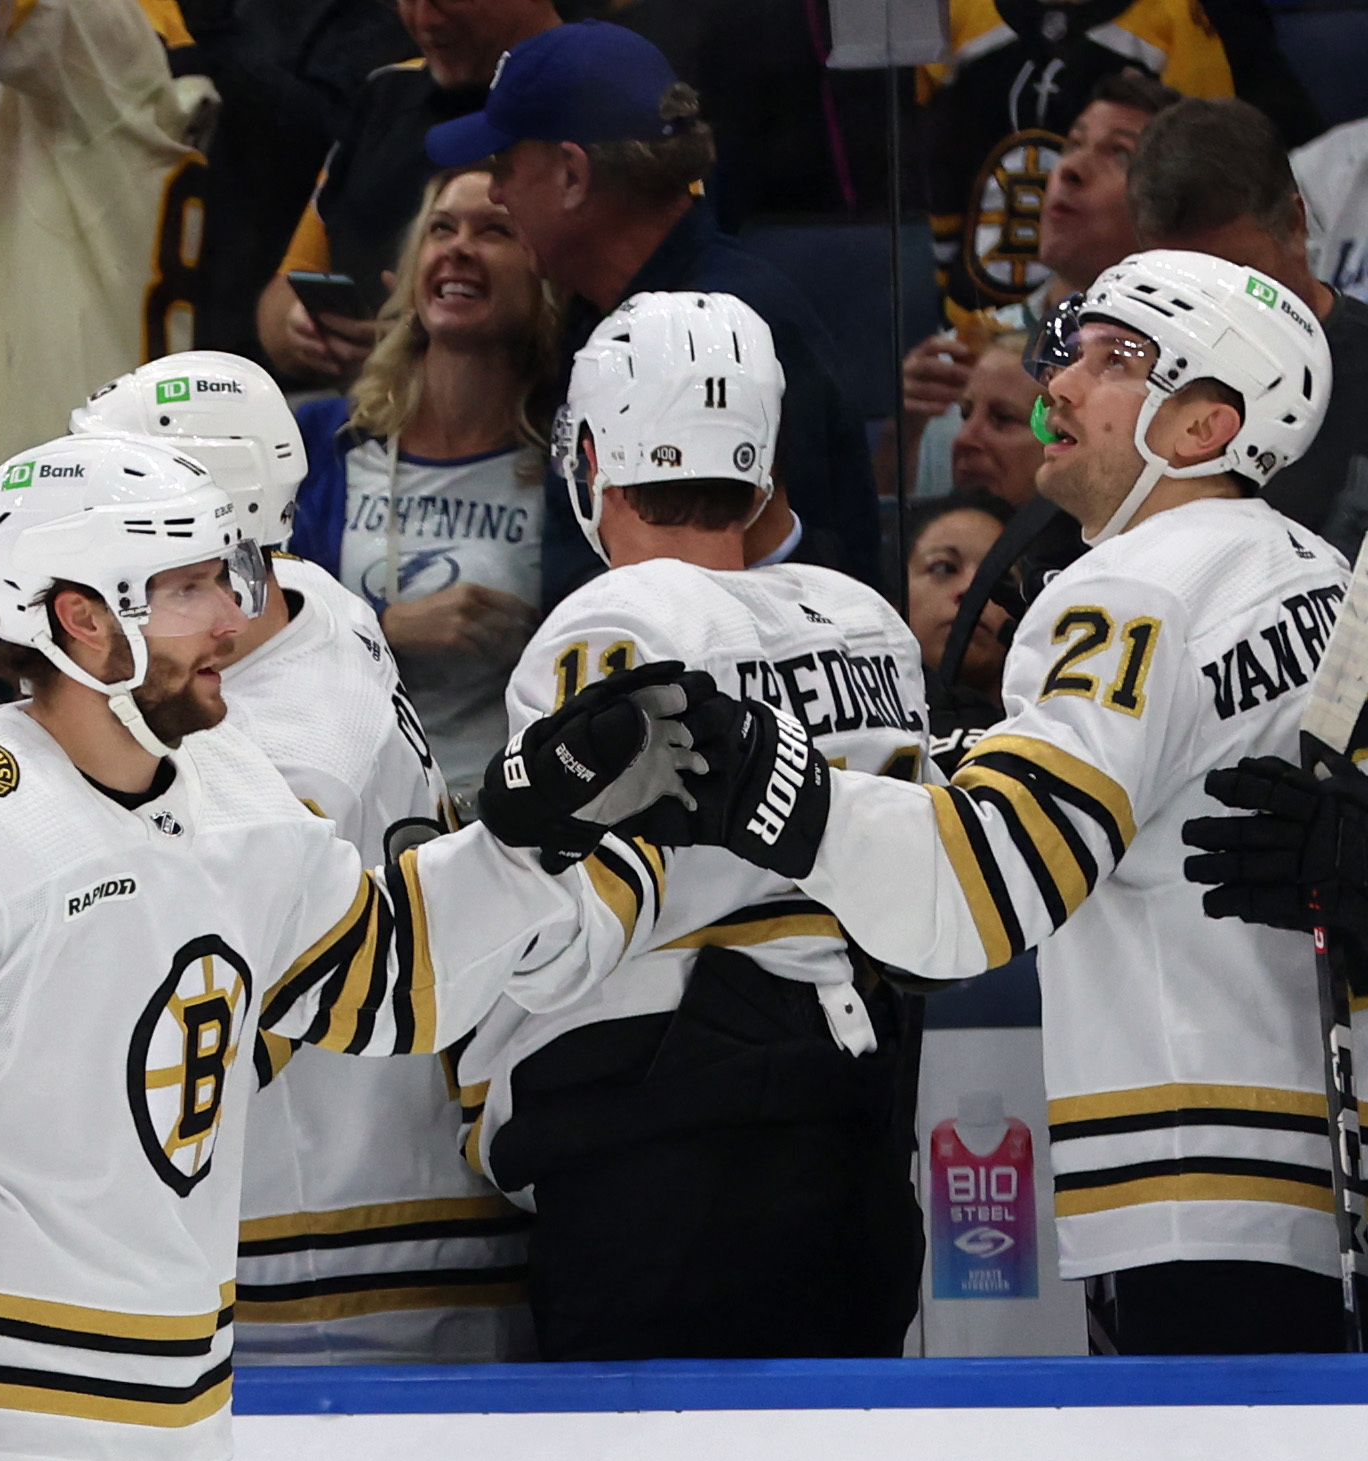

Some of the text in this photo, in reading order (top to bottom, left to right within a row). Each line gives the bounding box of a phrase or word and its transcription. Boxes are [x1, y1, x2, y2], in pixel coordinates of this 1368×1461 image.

[1281, 301, 1314, 337] Bank
[157, 379, 243, 402] TD Bank
[704, 376, 727, 409] 11
[39, 464, 85, 478] Bank
[1038, 604, 1163, 719] 21
[746, 704, 809, 846] RRIOR
[177, 987, 234, 1144] B
[947, 1165, 1018, 1203] BIO
[950, 1204, 1016, 1223] STEEL
